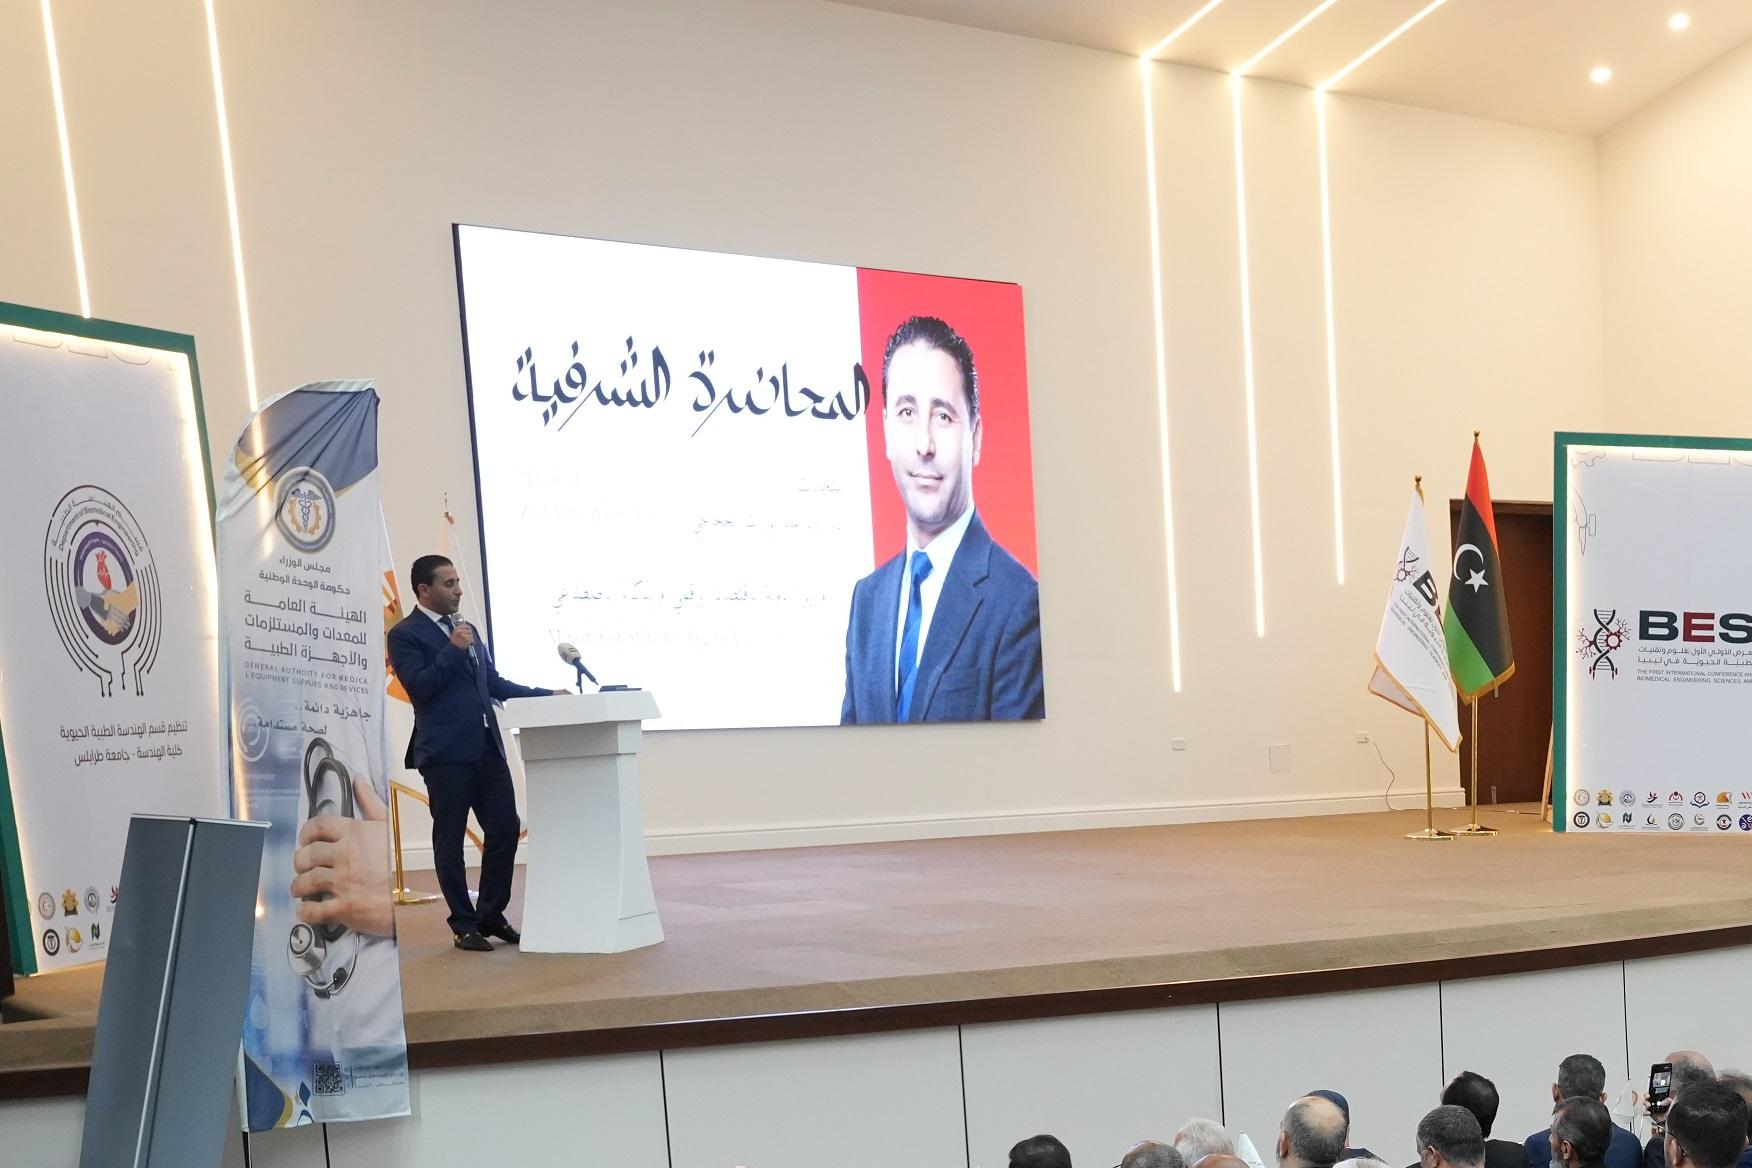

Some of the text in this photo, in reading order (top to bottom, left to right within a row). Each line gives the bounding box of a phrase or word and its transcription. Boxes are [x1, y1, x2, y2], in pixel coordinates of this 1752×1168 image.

[511, 335, 871, 439] المحاضرة الشرفية
[304, 561, 331, 573] مجلس
[259, 570, 350, 595] حكومة الوحدة الوطنية
[244, 590, 366, 624] الهيئة العامة
[245, 614, 366, 645] للمعدات والمستلزمات
[244, 636, 297, 657] الطبية
[1638, 646, 1666, 655] وتقنيات
[1691, 647, 1706, 656] الأول
[1708, 648, 1732, 657] الدولي
[1637, 656, 1663, 664] ليبيا
[1663, 657, 1680, 666] في
[1683, 657, 1721, 666] الحيوية
[245, 661, 279, 673] GENERAL
[321, 672, 336, 680] FOR
[338, 675, 368, 685] MEDICA
[250, 672, 289, 683] EQUIPMENT
[333, 704, 371, 722] جاهزية
[60, 720, 188, 742] تنظيم قسم الهندسة الطبية الحيوية
[300, 721, 327, 735] لصحة
[74, 748, 104, 767] طرابلس
[106, 748, 130, 763] جامعة
[137, 745, 166, 761] الهندسة
[167, 744, 183, 760] كلية
